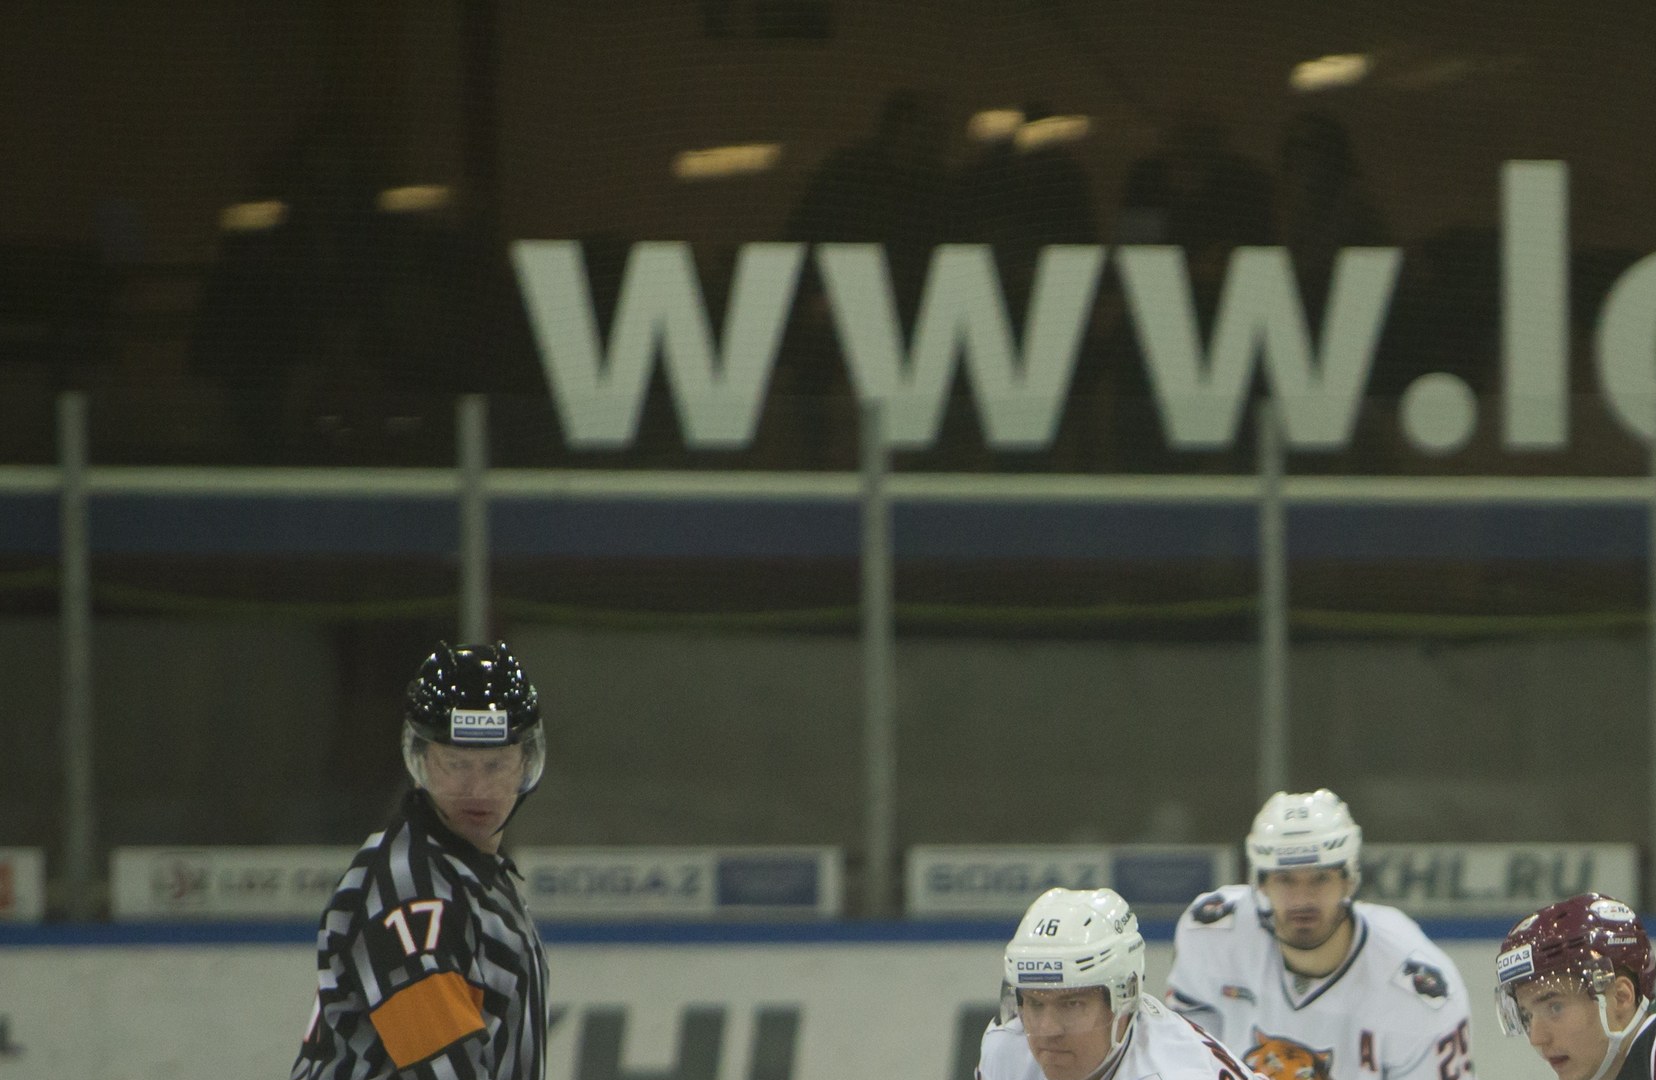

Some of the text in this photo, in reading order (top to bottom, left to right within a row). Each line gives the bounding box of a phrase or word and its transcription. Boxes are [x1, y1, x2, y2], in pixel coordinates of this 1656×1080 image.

[453, 715, 506, 725] СОГАЗ
[384, 900, 444, 957] 17
[1034, 918, 1060, 936] 46
[1017, 961, 1063, 971] СОГАЗ
